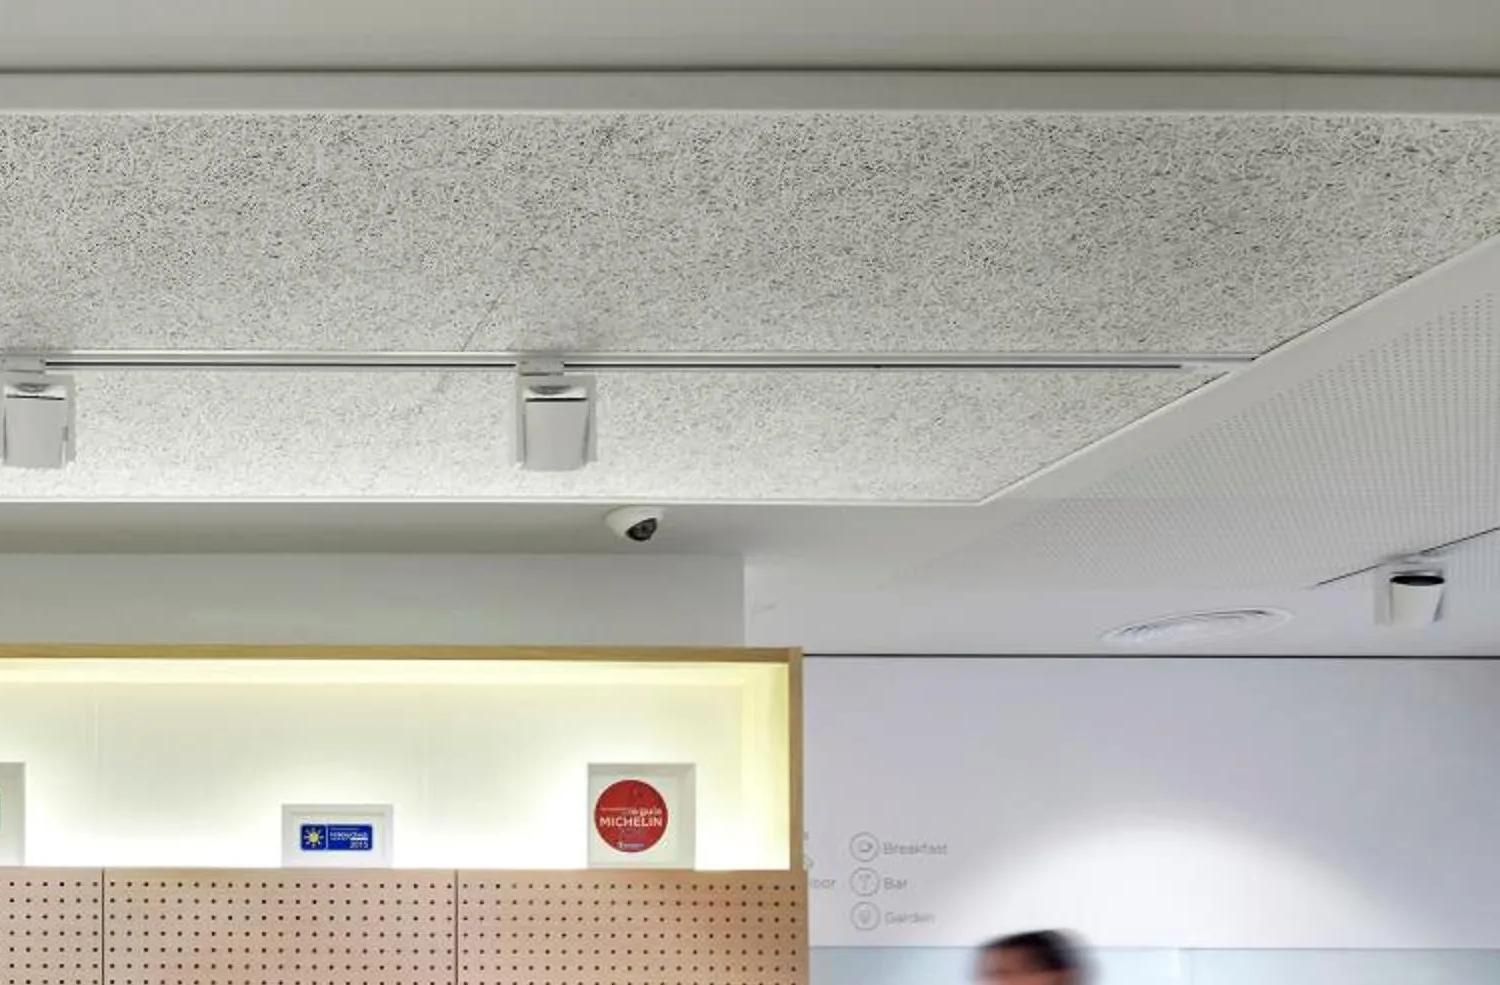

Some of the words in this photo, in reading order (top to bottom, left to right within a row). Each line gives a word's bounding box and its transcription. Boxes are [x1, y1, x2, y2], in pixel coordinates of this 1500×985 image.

[599, 816, 662, 827] MICHELIN
[883, 841, 948, 855] Breakfast
[883, 877, 908, 890] Bar
[884, 911, 935, 925] Garden
